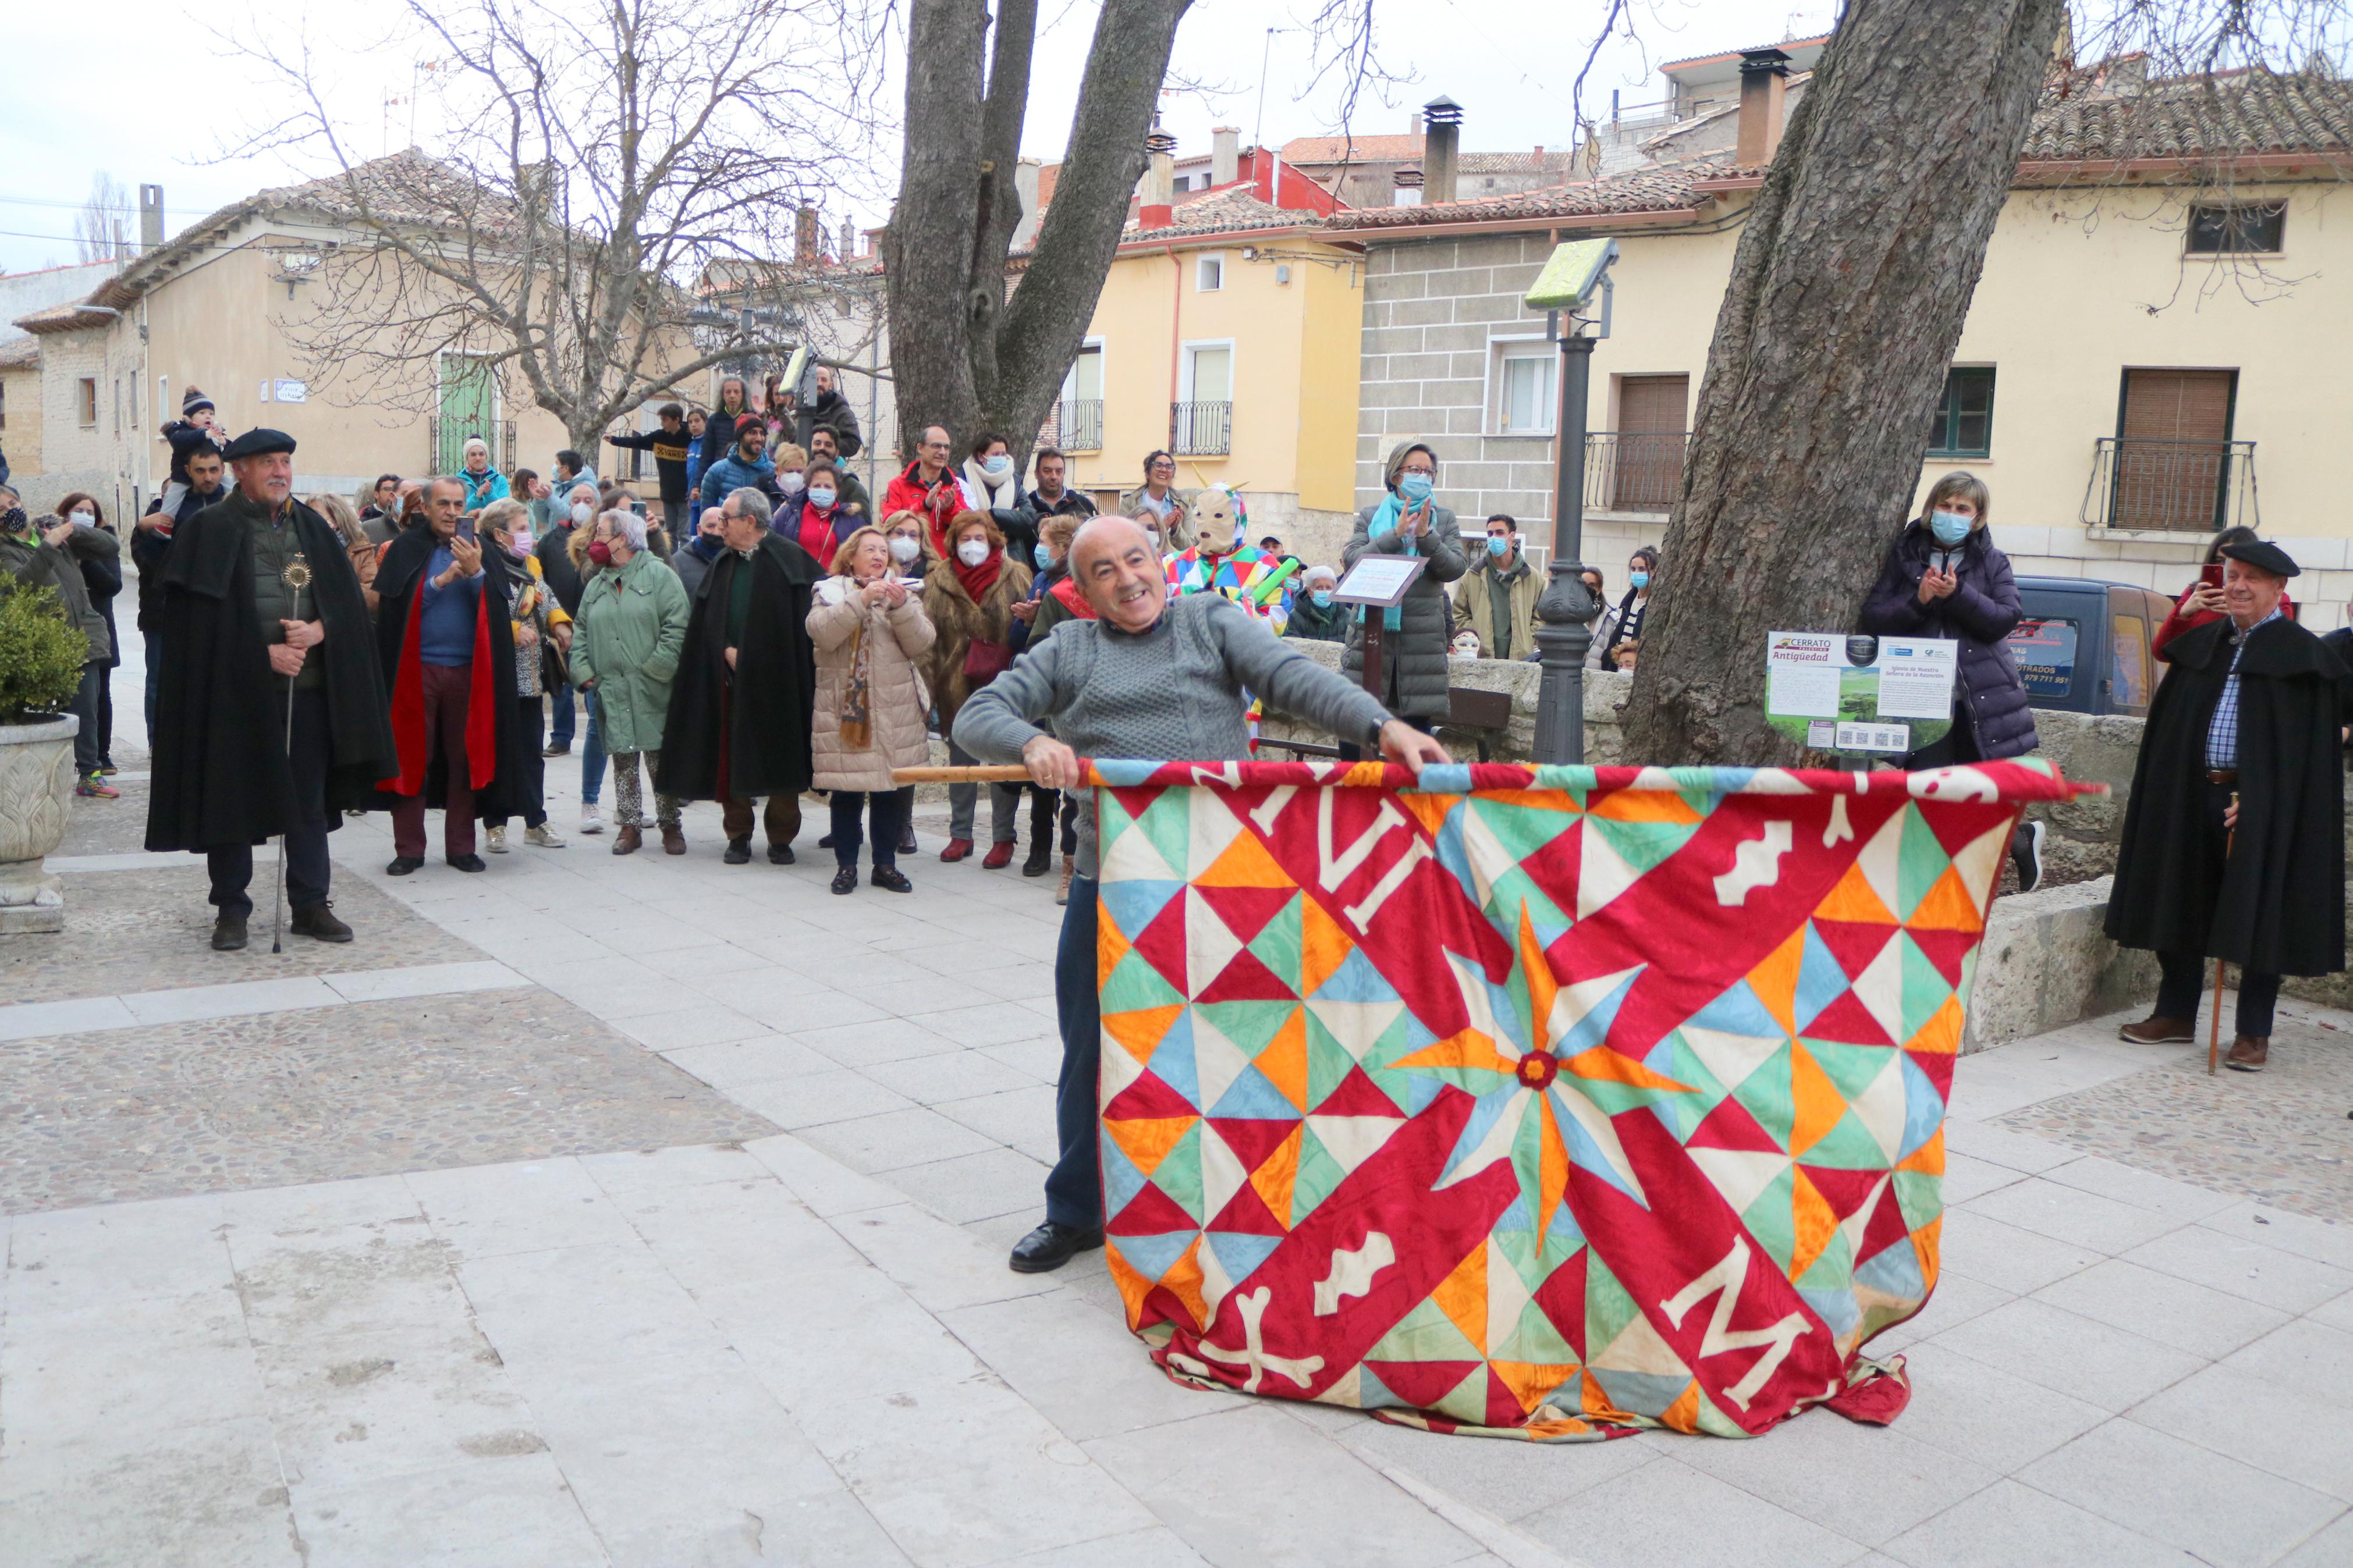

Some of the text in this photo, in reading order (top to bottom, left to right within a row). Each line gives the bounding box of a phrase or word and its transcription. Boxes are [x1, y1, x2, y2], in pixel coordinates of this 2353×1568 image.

[1791, 638, 1831, 648] CERRATO
[1773, 652, 1828, 662] Antigüedad
[2016, 665, 2056, 674] OTRADOS
